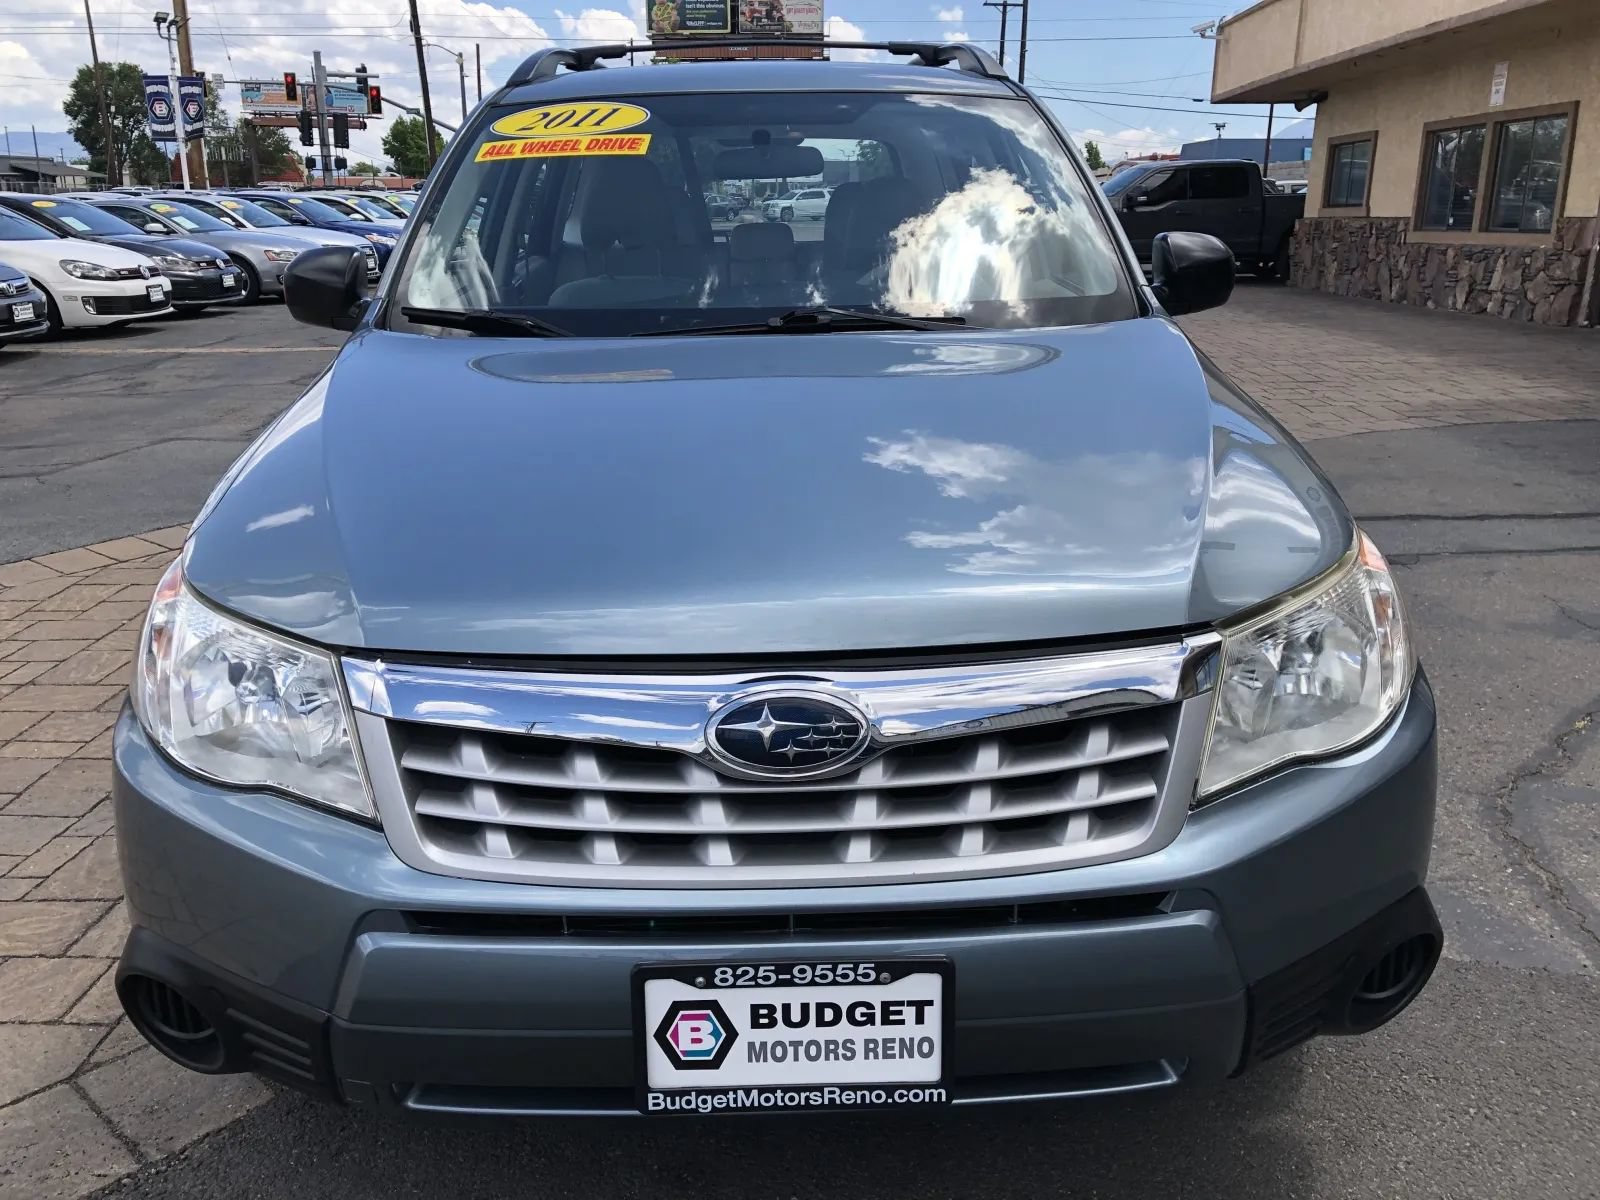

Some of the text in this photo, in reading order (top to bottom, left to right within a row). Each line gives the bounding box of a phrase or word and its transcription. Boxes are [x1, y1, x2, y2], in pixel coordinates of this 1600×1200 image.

[514, 107, 621, 131] 2011
[482, 137, 644, 158] ALL WHEEL DRIVE
[713, 963, 877, 987] 825-9555
[750, 1000, 934, 1030] BUDGET
[677, 1020, 717, 1051] B
[747, 1036, 935, 1063] MOTORS RENO
[647, 1087, 947, 1113] BudgetMotorsReno.com
